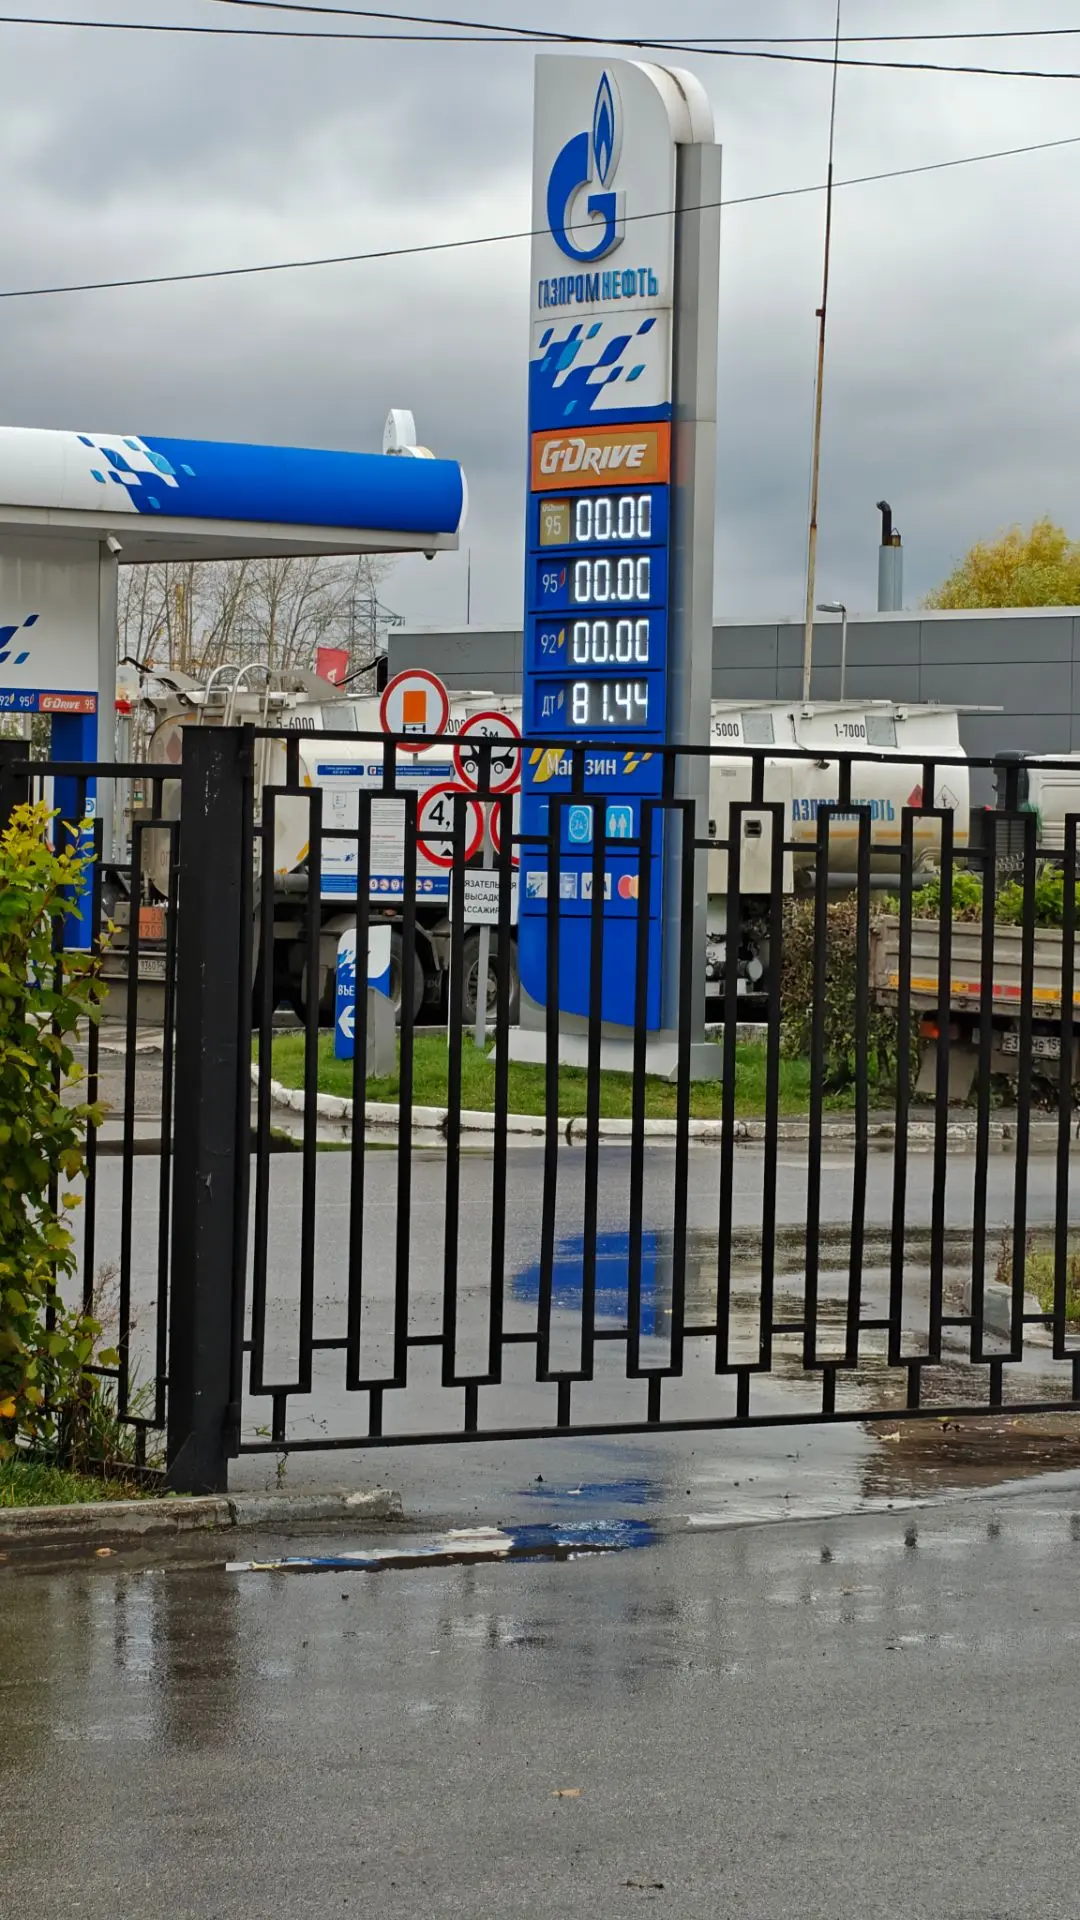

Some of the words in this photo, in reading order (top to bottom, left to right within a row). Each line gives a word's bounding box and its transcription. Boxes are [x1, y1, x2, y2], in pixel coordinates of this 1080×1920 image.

[538, 267, 659, 309] ГАЗПРОМНЕФТЬ
[545, 515, 562, 536] 95
[576, 495, 652, 541] 00.00
[542, 573, 558, 593] 95
[575, 557, 650, 602] 00.00
[541, 634, 557, 654] 92
[573, 619, 649, 663] 00.00
[20, 696, 30, 708] 95
[85, 699, 95, 709] 95
[541, 695, 556, 717] ДТ
[572, 683, 648, 724] 81.44
[711, 723, 739, 737] -5000
[834, 723, 865, 738] 1-7000
[547, 753, 617, 776] Магзин
